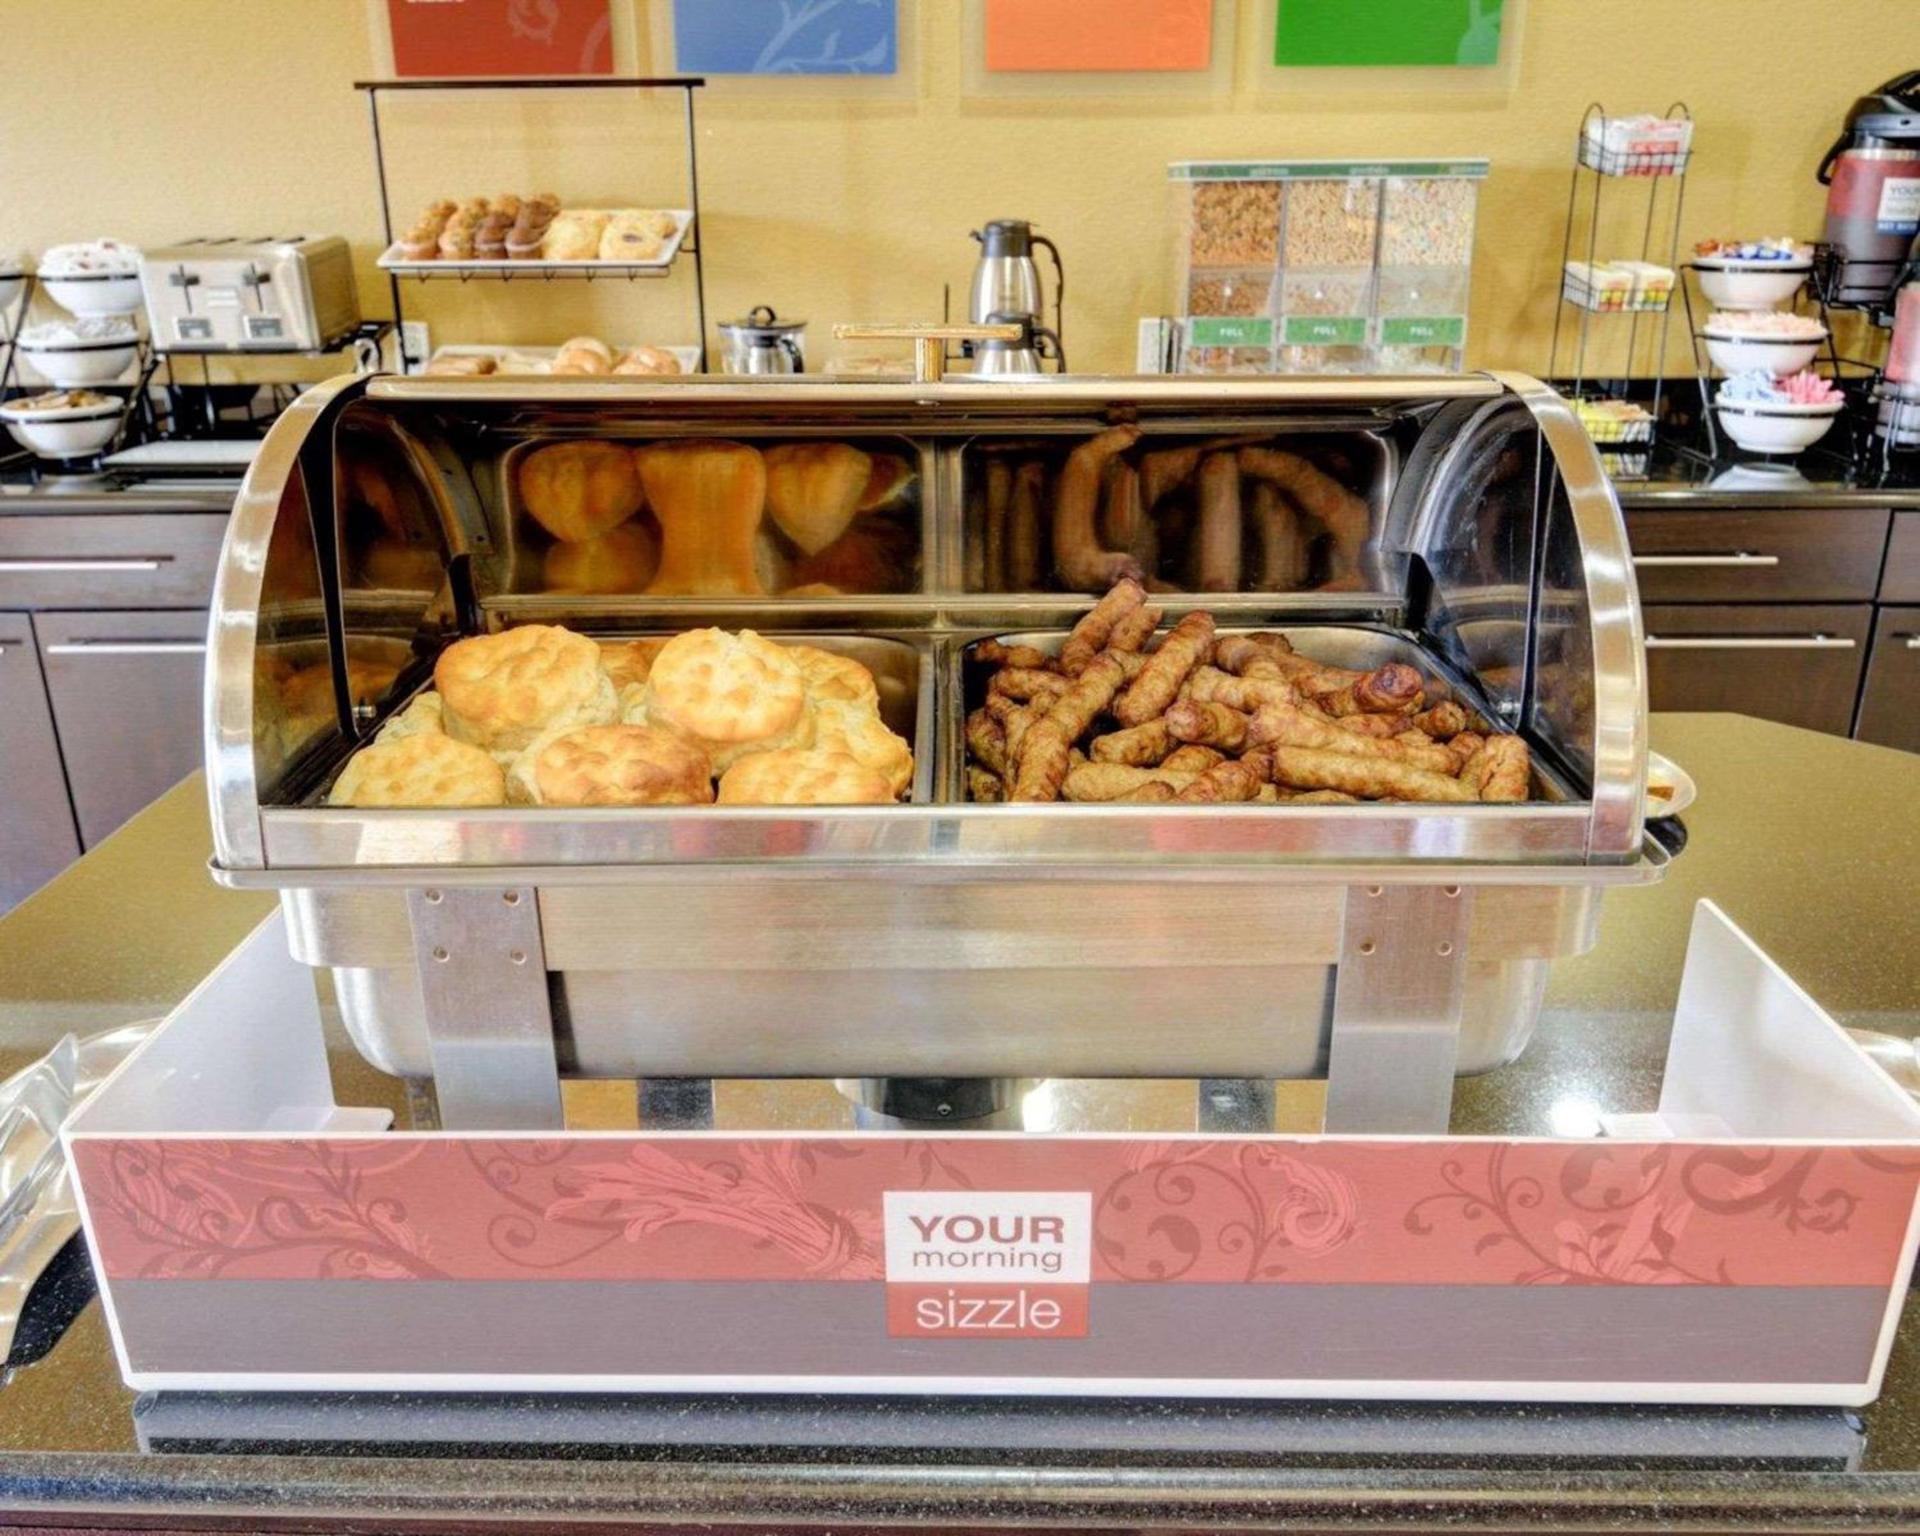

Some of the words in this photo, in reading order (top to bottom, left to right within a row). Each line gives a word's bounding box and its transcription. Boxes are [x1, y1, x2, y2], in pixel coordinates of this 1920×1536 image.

[909, 1215, 1065, 1243] YOUR
[912, 1247, 1063, 1273] morning
[916, 1289, 1062, 1329] sizzle
